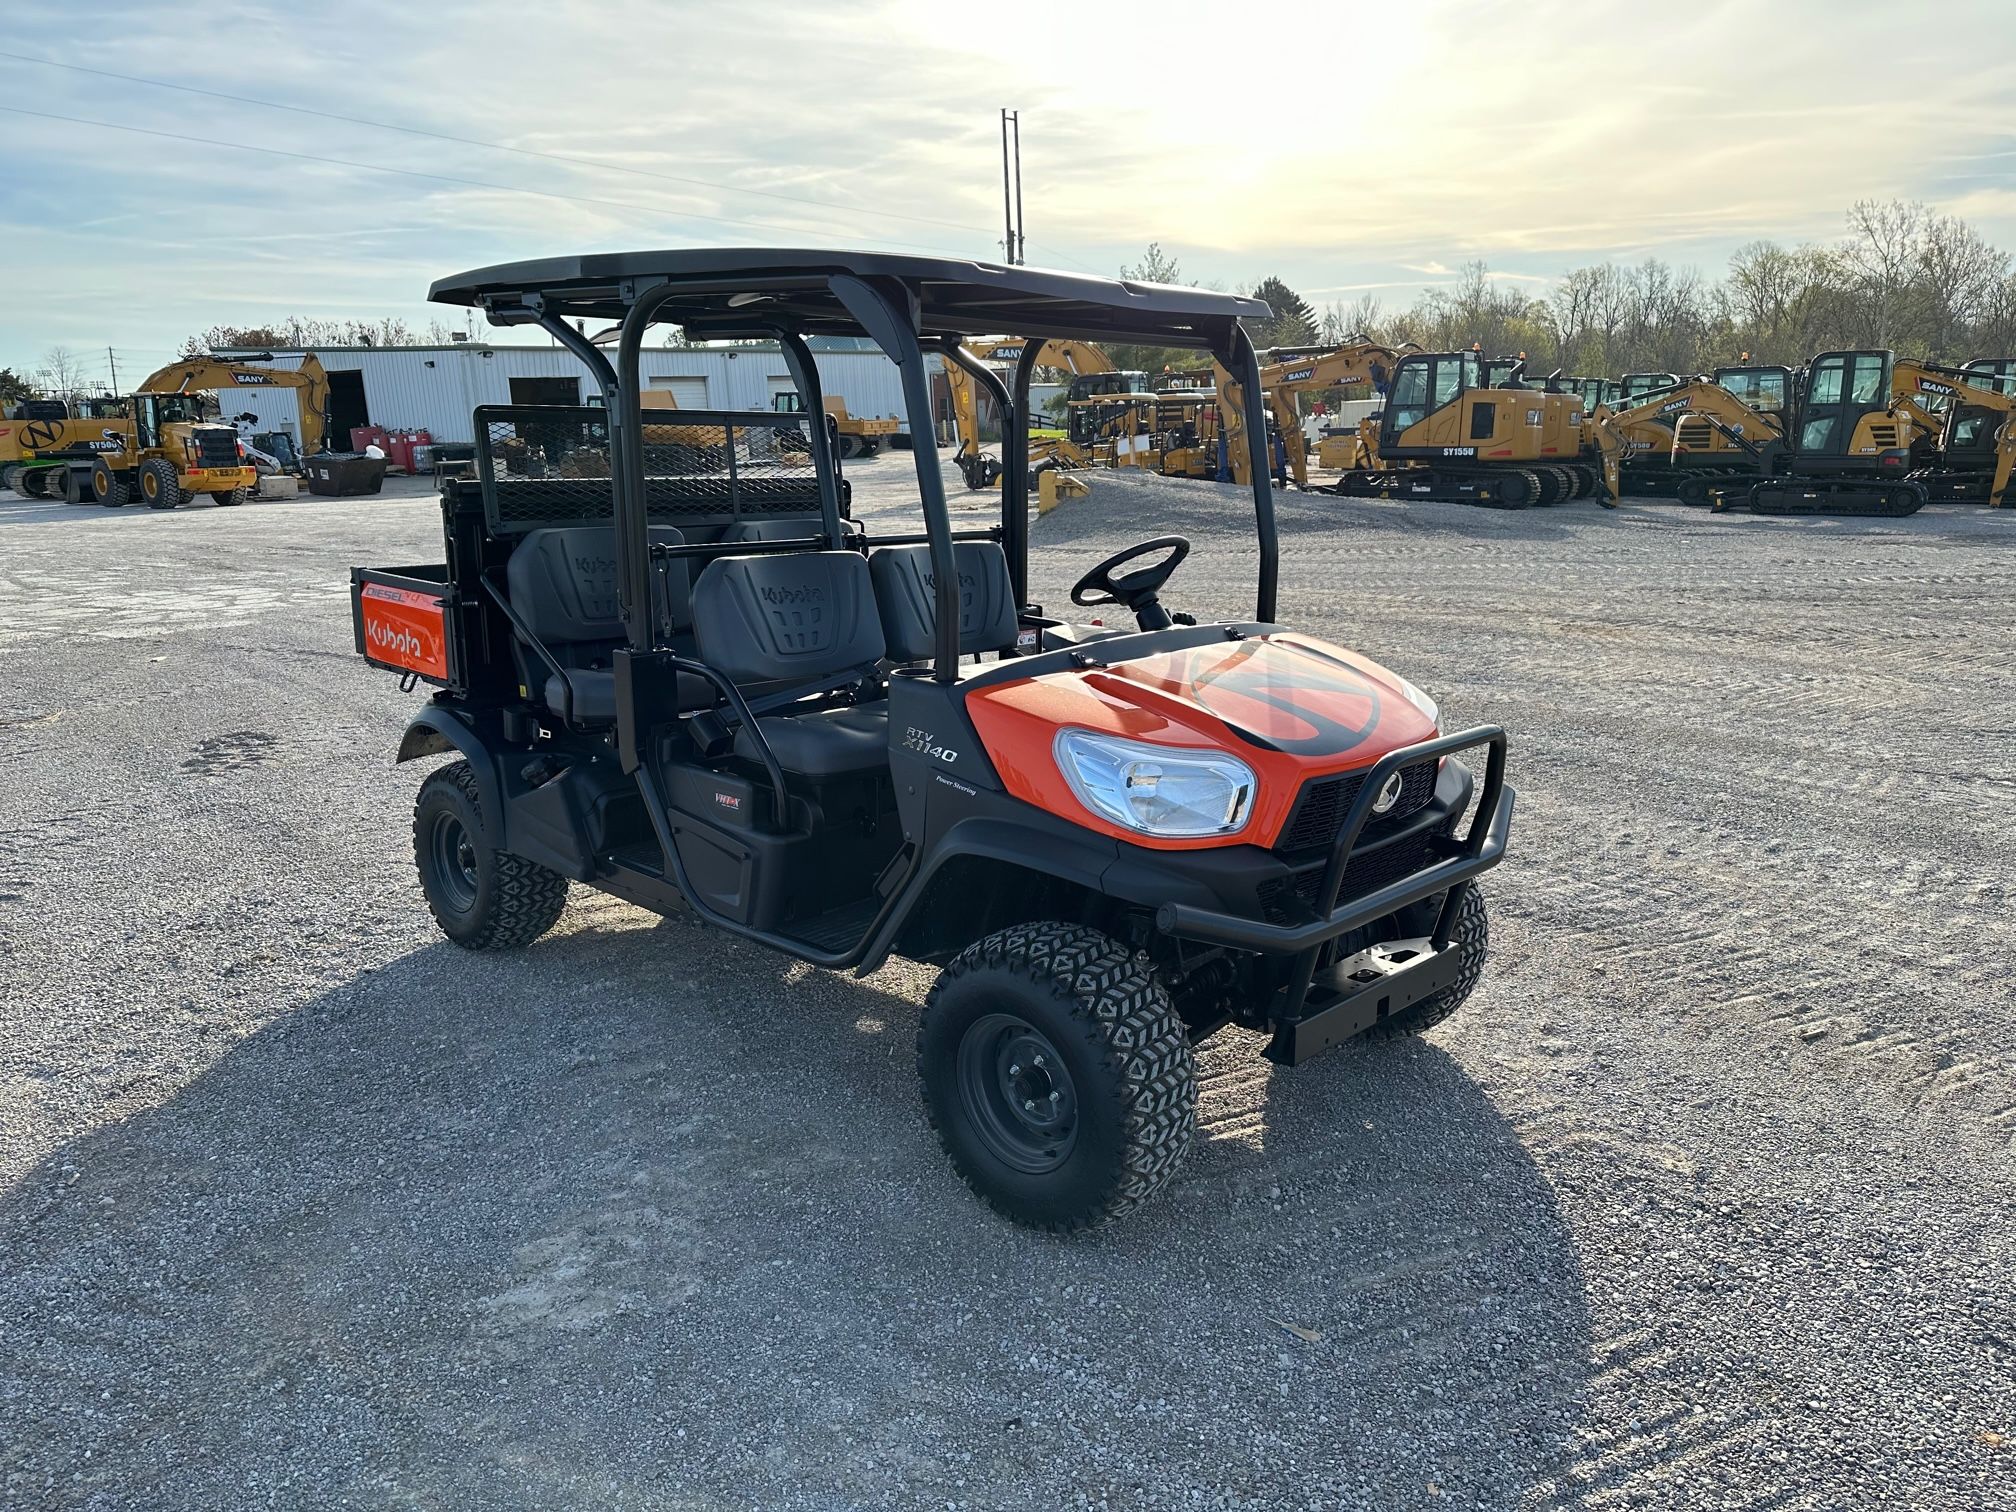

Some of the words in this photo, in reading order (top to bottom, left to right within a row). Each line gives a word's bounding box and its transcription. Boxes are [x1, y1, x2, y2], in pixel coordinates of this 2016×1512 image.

[237, 375, 264, 383] SANY
[1288, 370, 1312, 380] SANY
[1921, 382, 1953, 395] SANY
[1664, 399, 1688, 412] SANY
[1443, 447, 1474, 456] SY155U
[366, 587, 406, 603] DIESEL
[760, 585, 824, 604] Kubota
[367, 618, 421, 657] Kubota
[906, 726, 934, 742] RTV
[902, 735, 958, 763] X1140
[936, 775, 954, 786] Power
[952, 781, 977, 796] Steering
